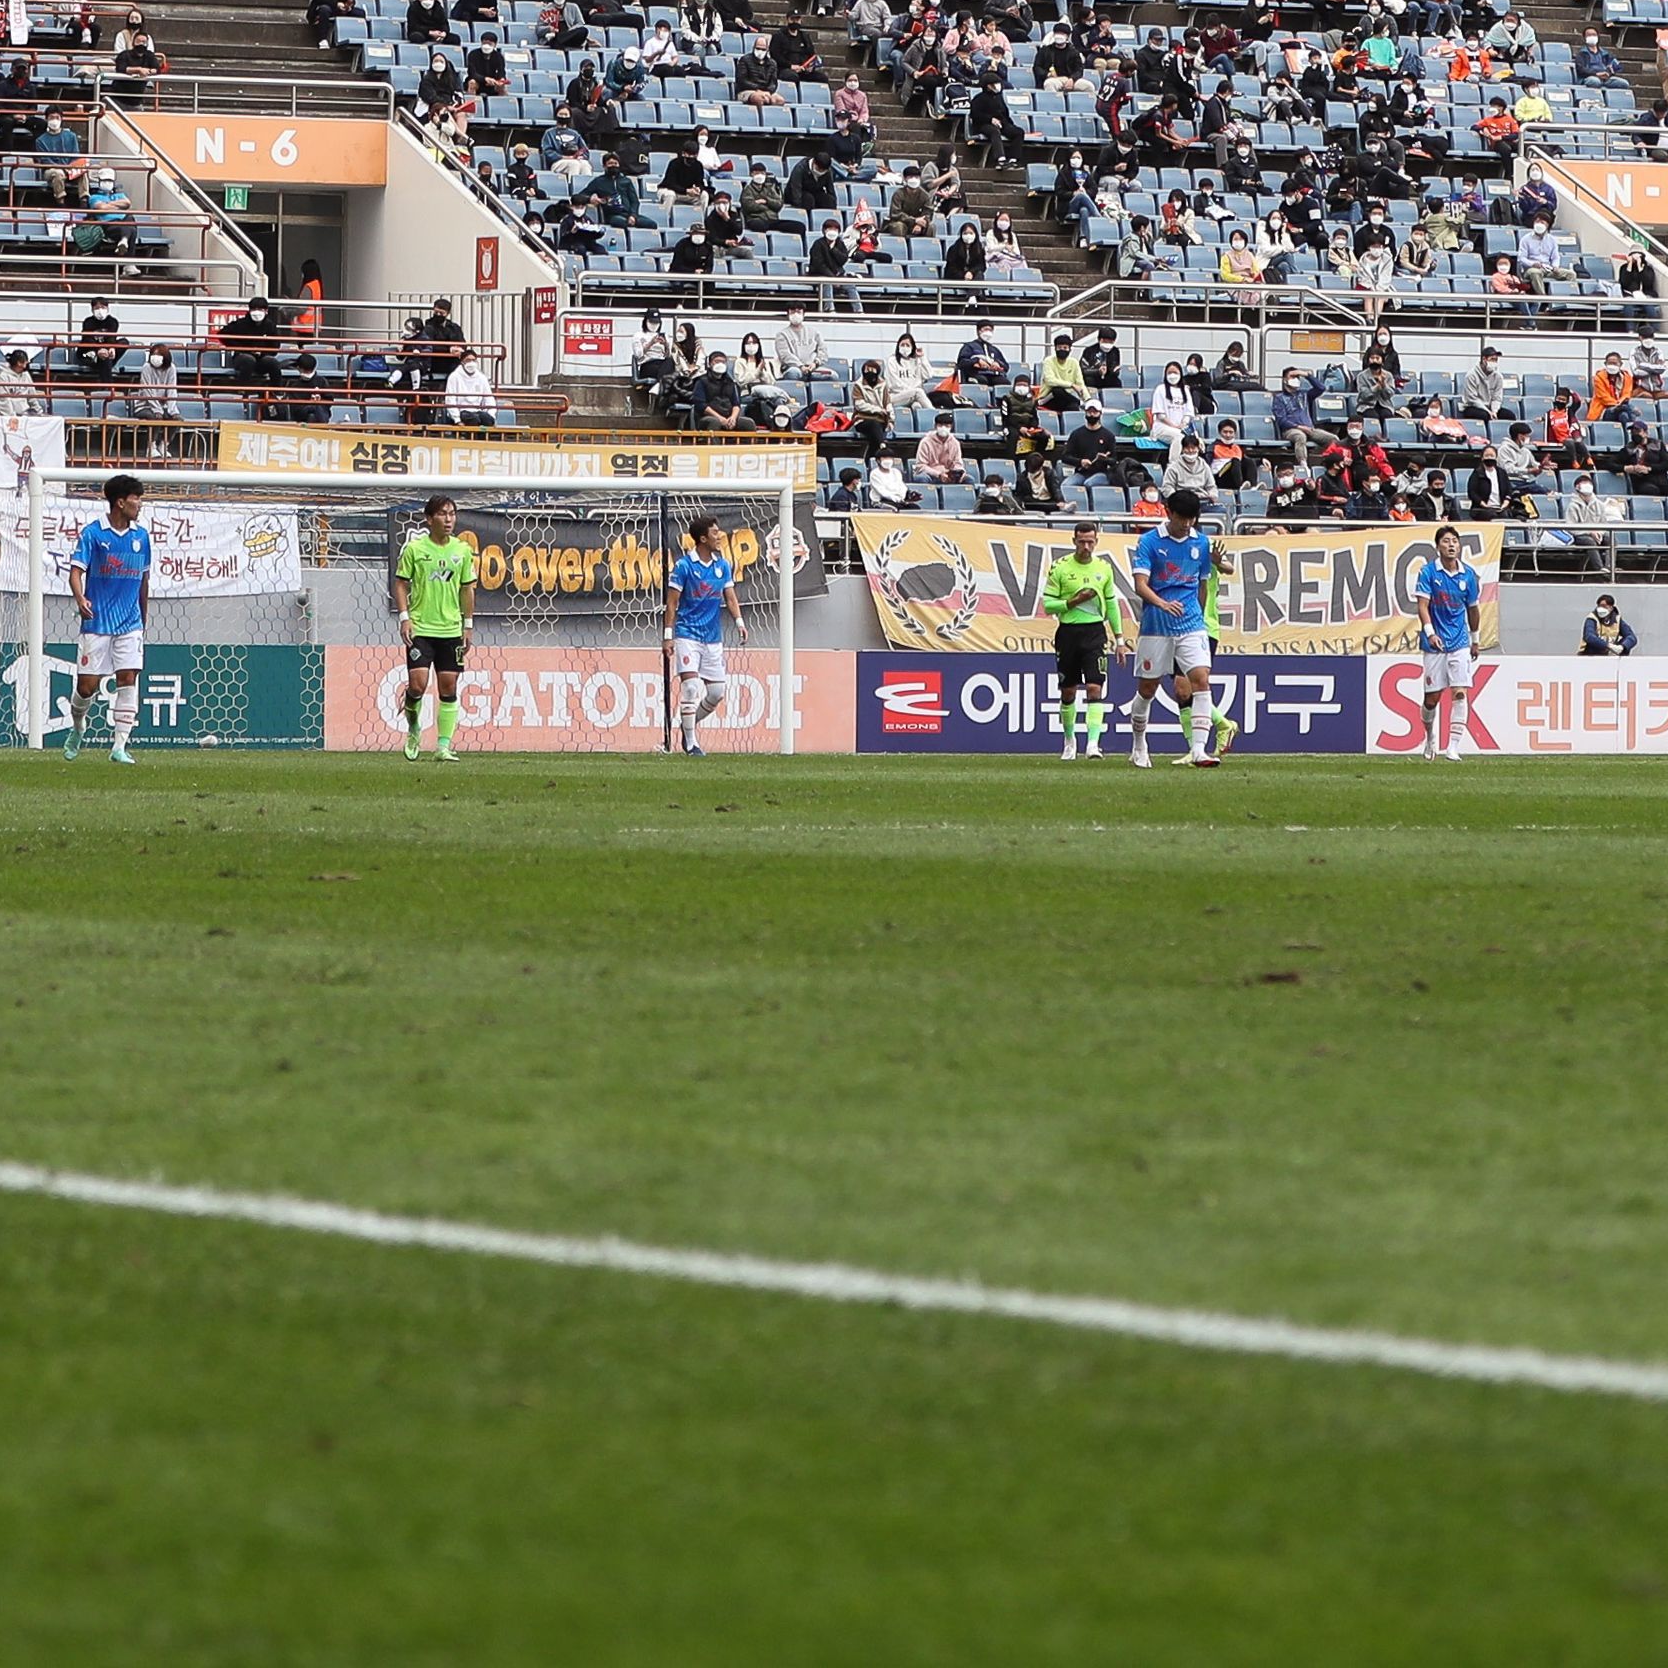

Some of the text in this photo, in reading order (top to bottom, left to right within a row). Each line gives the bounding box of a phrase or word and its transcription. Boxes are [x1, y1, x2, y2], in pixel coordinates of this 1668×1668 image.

[583, 323, 612, 334] 화장실
[236, 432, 340, 472] 제주여!
[349, 441, 443, 474] 심장이
[159, 556, 240, 581] 행복해!!
[513, 546, 611, 592] over
[453, 670, 805, 732] GATORDE
[1375, 662, 1500, 752] SK
